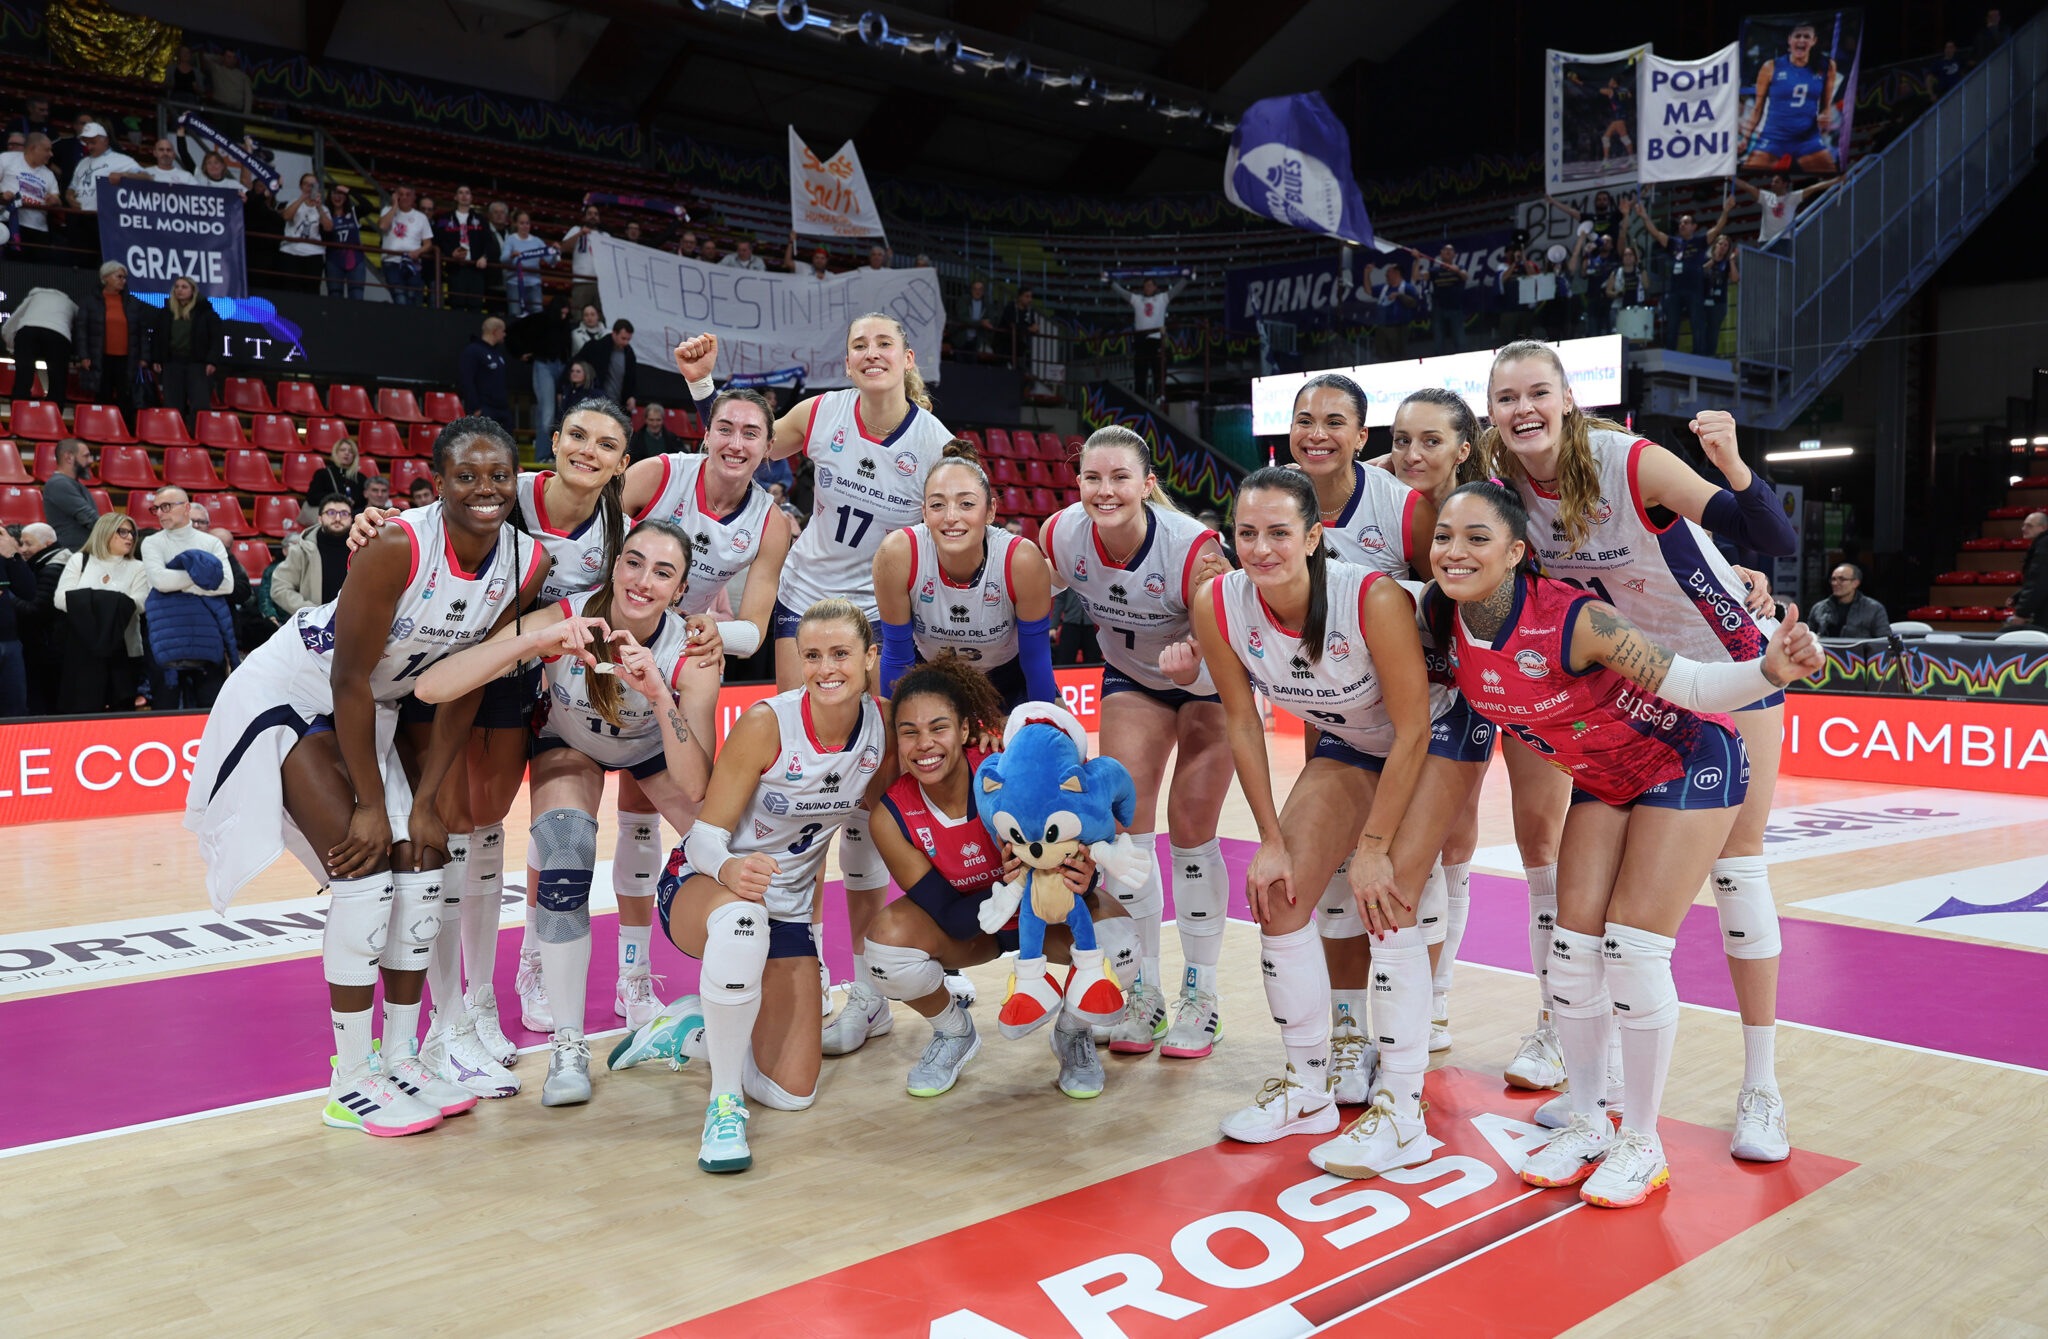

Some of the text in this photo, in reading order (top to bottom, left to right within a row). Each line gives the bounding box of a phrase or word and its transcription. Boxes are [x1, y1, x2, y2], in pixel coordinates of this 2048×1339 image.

[1651, 62, 1730, 93] POHI
[1790, 84, 1809, 107] 9
[1663, 99, 1716, 127] MA
[1646, 131, 1730, 161] BÒNI
[246, 155, 272, 180] VOLLEY
[116, 188, 225, 217] CAMPIONESSE
[119, 213, 225, 236] DEL MONDO
[126, 245, 224, 284] GRAZIE
[600, 240, 677, 317] THE
[678, 263, 790, 332] BEST
[1243, 268, 1350, 319] BIANCO
[857, 469, 875, 480] errea
[836, 476, 912, 506] SAVINO DEL BENE
[834, 504, 874, 549] 17
[1575, 552, 1596, 562] DEL
[1598, 545, 1631, 562] BENE
[699, 563, 716, 575] DEL
[544, 586, 563, 597] DEL
[1109, 594, 1128, 605] errea
[1559, 577, 1617, 608] 1
[446, 612, 465, 622] errea
[1093, 602, 1126, 617] SAVINO
[1127, 611, 1147, 621] DEL
[419, 625, 454, 638] SAVINO
[931, 619, 1010, 638] SAVINO DEL BENE
[1111, 626, 1135, 651] 7
[1272, 672, 1373, 698] SAVINO DEL BENE
[1291, 670, 1315, 680] errea
[1483, 685, 1505, 695] errea
[618, 709, 640, 718] DEL
[1470, 690, 1570, 715] SAVINO DEL BENE
[0, 748, 53, 798] E
[819, 785, 840, 794] errea
[795, 801, 832, 811] SAVINO
[833, 800, 851, 809] DEL
[788, 822, 823, 855] 3
[963, 854, 988, 868] errea
[949, 865, 1005, 887] SAVINO DE
